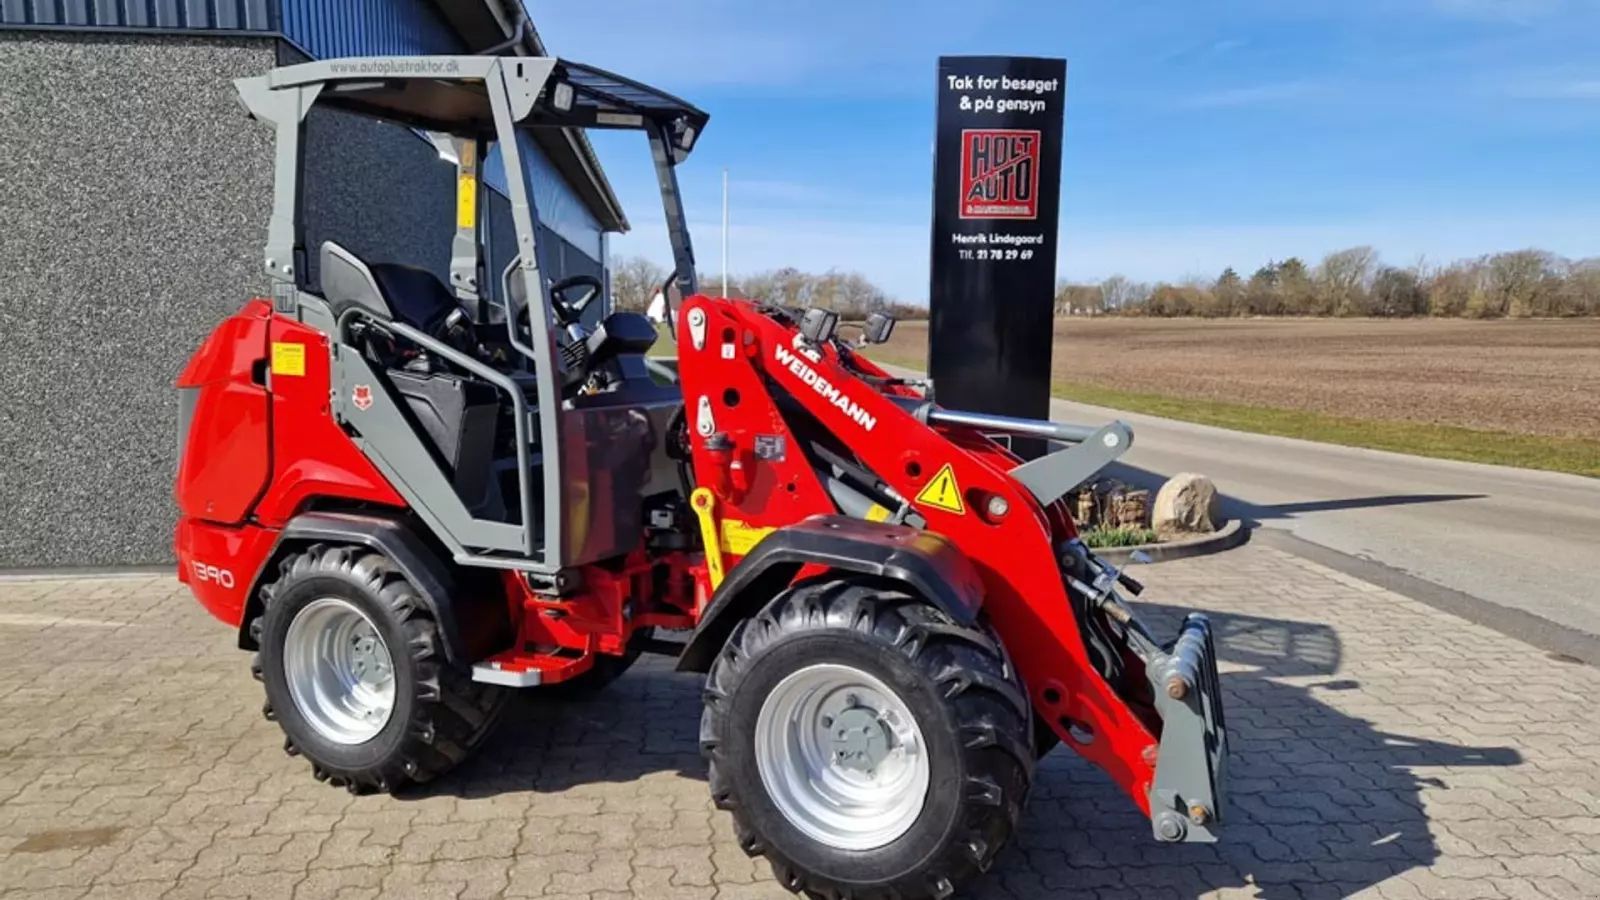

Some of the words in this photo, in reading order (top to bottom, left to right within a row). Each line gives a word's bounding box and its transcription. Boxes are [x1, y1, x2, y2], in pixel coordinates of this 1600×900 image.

[330, 59, 459, 75] www.autoplustraktor.dk
[947, 75, 973, 90] Tak
[977, 75, 998, 90] for
[1001, 75, 1058, 94] besøget
[960, 95, 971, 110] &
[975, 95, 994, 113] på
[997, 99, 1046, 114] gensyn
[971, 134, 1033, 181] HOLT
[967, 155, 1032, 201] AUTO
[952, 233, 986, 244] Henrik
[988, 233, 1043, 246] Lindegaard
[990, 249, 1002, 260] 78
[1005, 249, 1018, 260] 29
[1020, 249, 1034, 260] 69
[775, 344, 877, 431] WEIDEMANN
